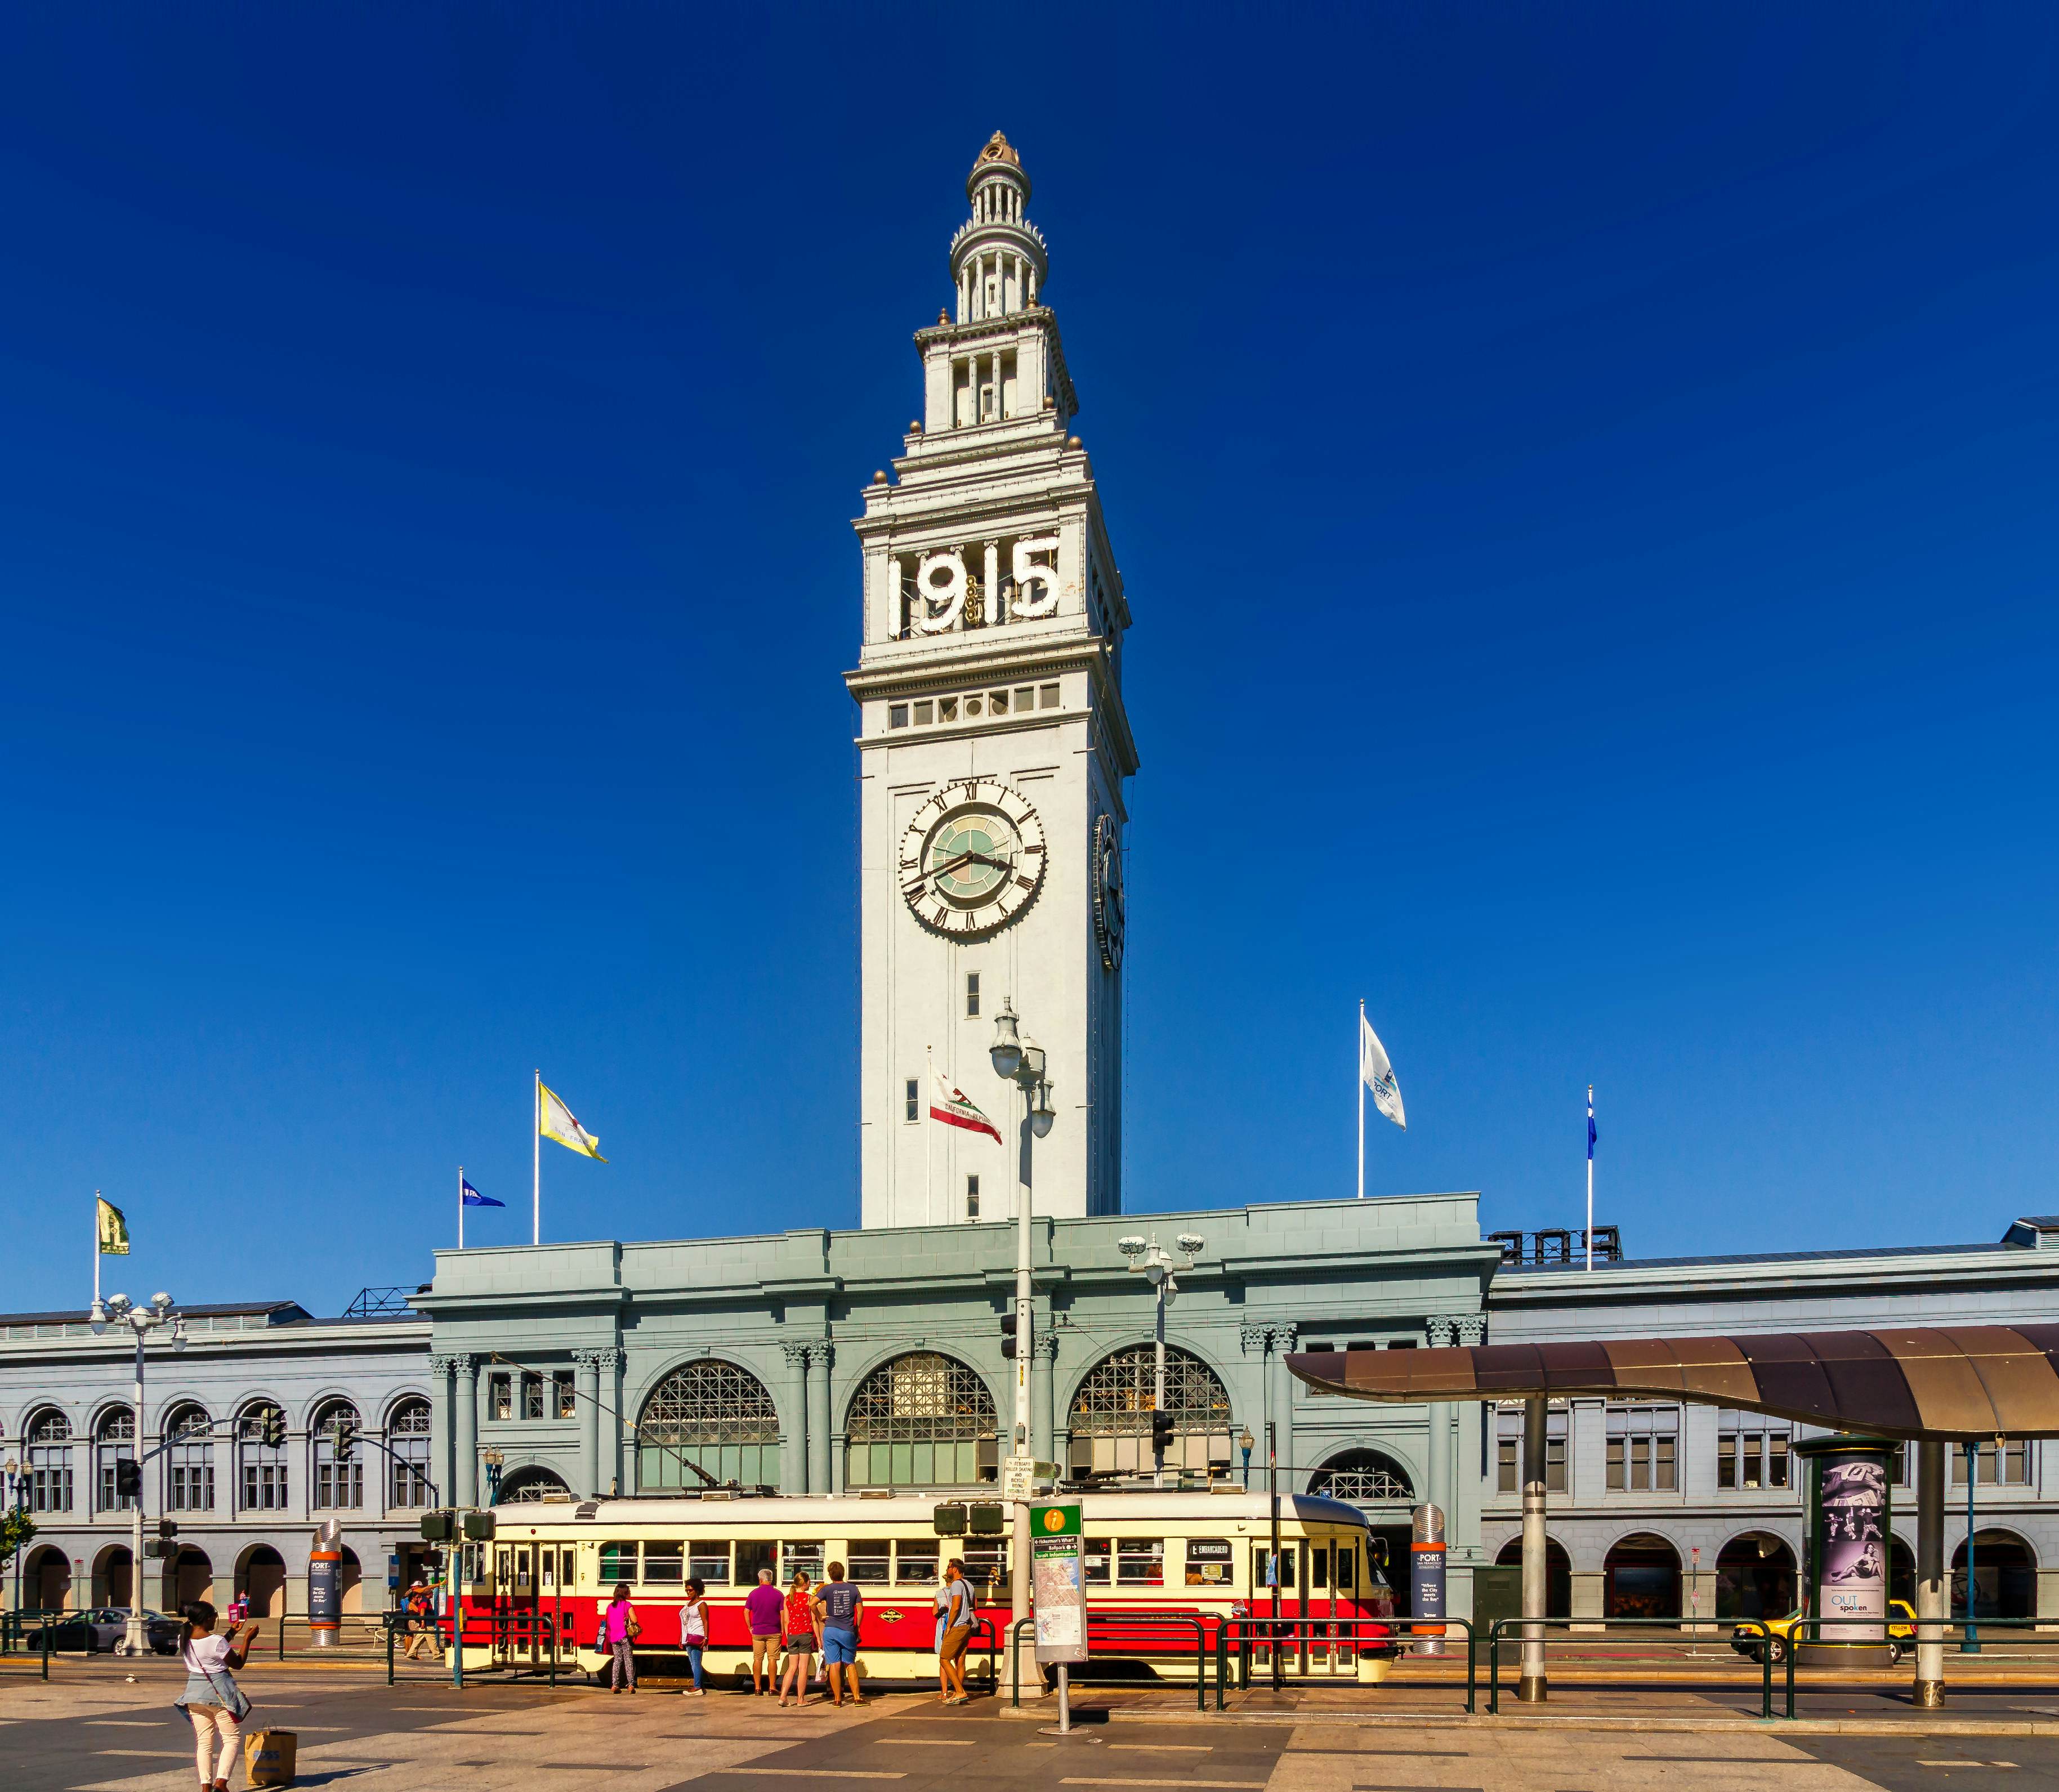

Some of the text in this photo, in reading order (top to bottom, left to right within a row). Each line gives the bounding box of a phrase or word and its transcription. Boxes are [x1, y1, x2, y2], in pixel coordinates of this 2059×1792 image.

[888, 536, 1061, 637] 1915
[945, 1103, 970, 1117] CALIFORNIA
[1199, 1545, 1228, 1554] EMBARCADERO
[1832, 1595, 1857, 1605] OUT
